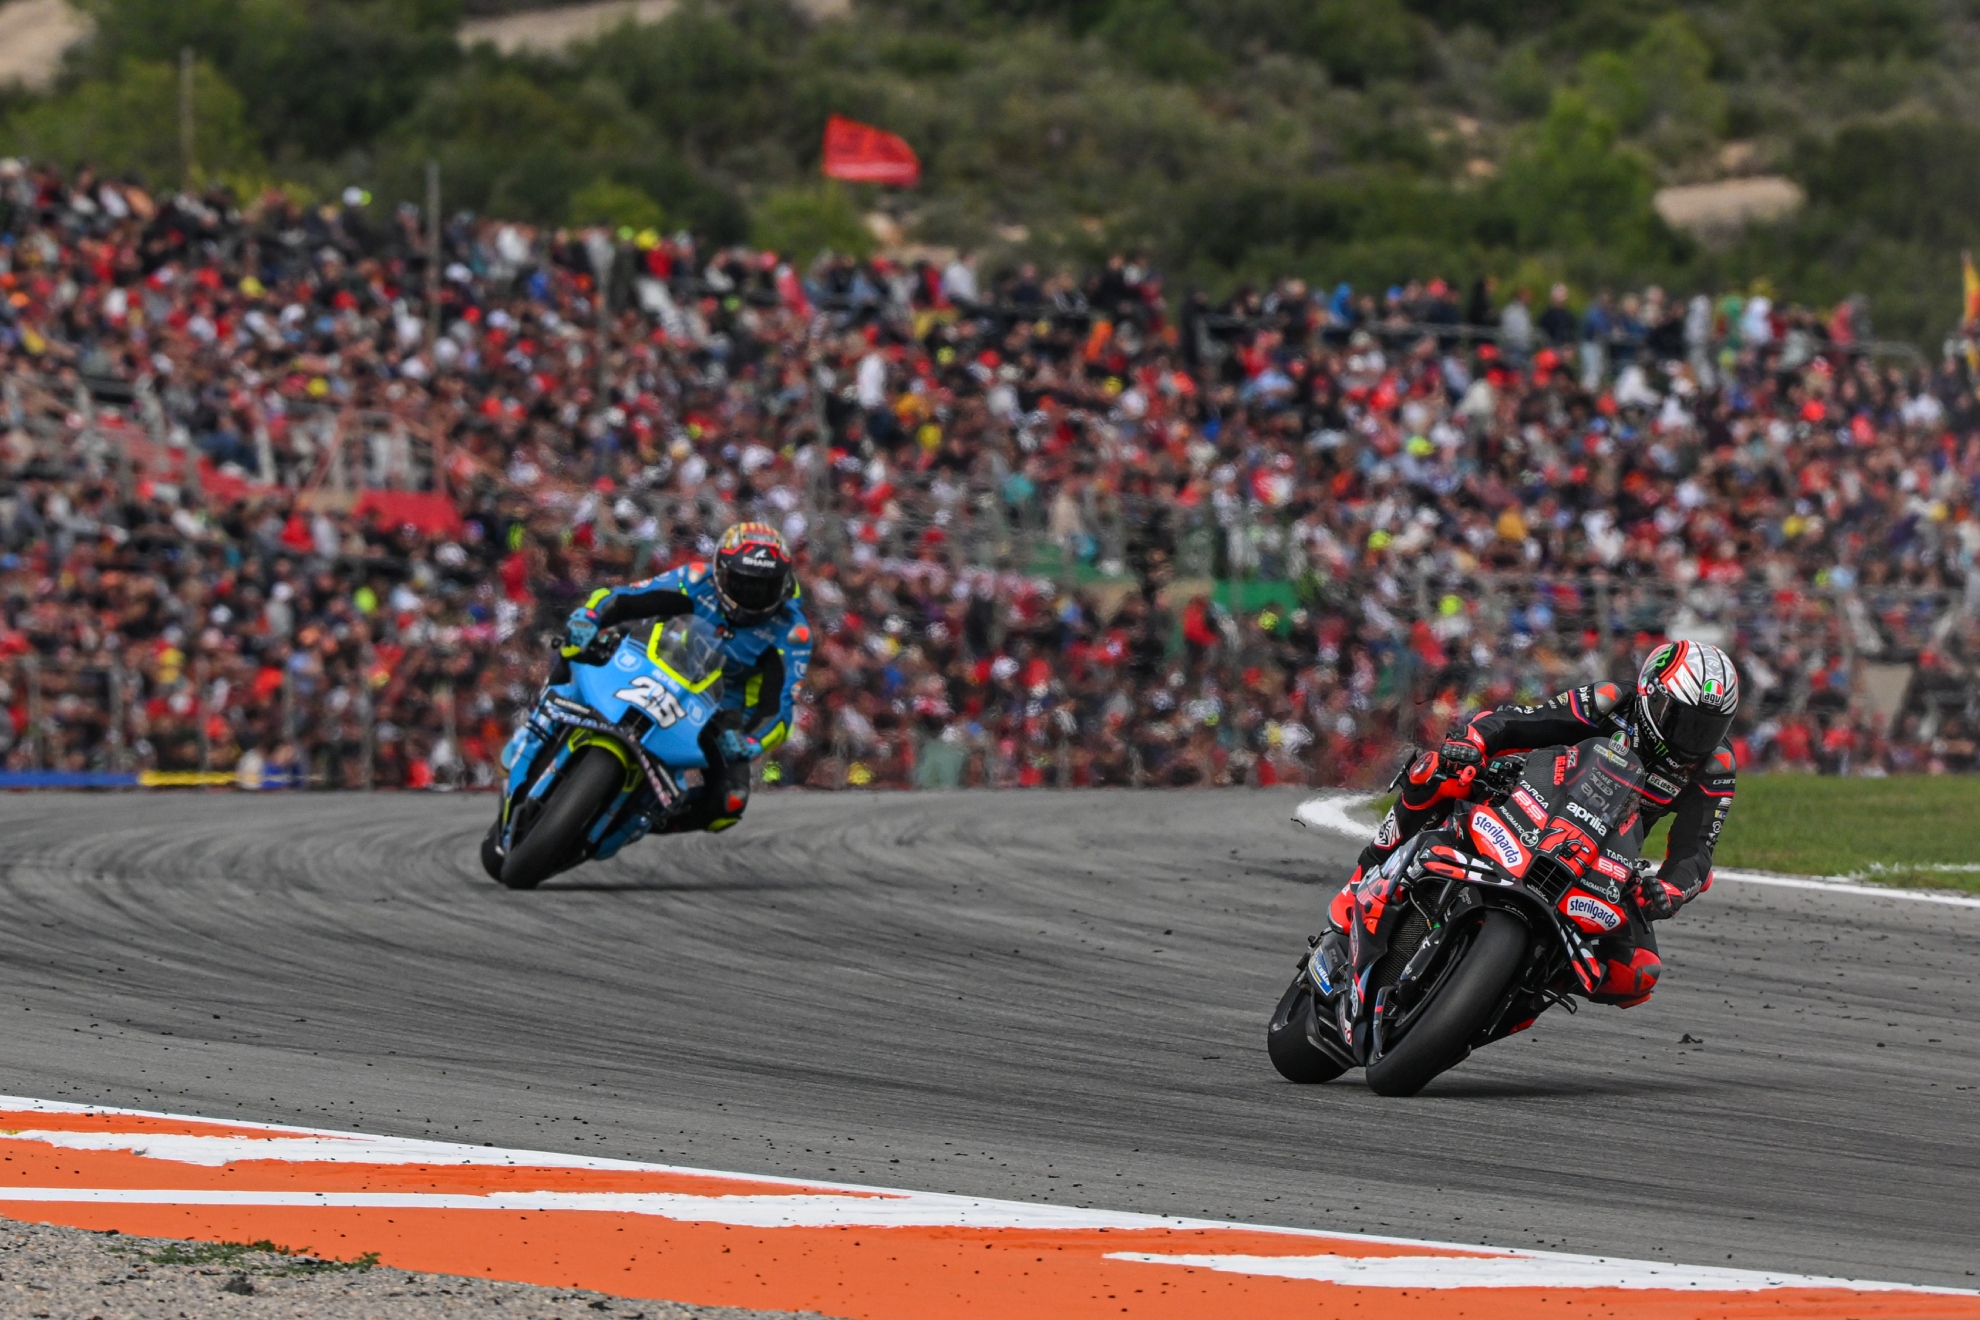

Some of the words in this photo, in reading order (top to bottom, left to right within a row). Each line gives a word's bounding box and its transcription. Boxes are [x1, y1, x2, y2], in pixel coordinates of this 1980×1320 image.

[742, 556, 776, 568] SHARK
[613, 676, 688, 729] 25
[1704, 692, 1721, 704] agv
[1513, 790, 1547, 820] BS
[1519, 779, 1550, 809] TARGA
[1499, 805, 1525, 835] PRAGMATIC
[1566, 802, 1608, 837] aprilia
[1474, 815, 1518, 864] sterilgarda
[1535, 816, 1599, 878] 72
[1598, 858, 1628, 879] BS
[1606, 849, 1634, 870] TARGA
[1580, 877, 1607, 896] PRAGMATIC
[1569, 898, 1617, 930] sterilgarda
